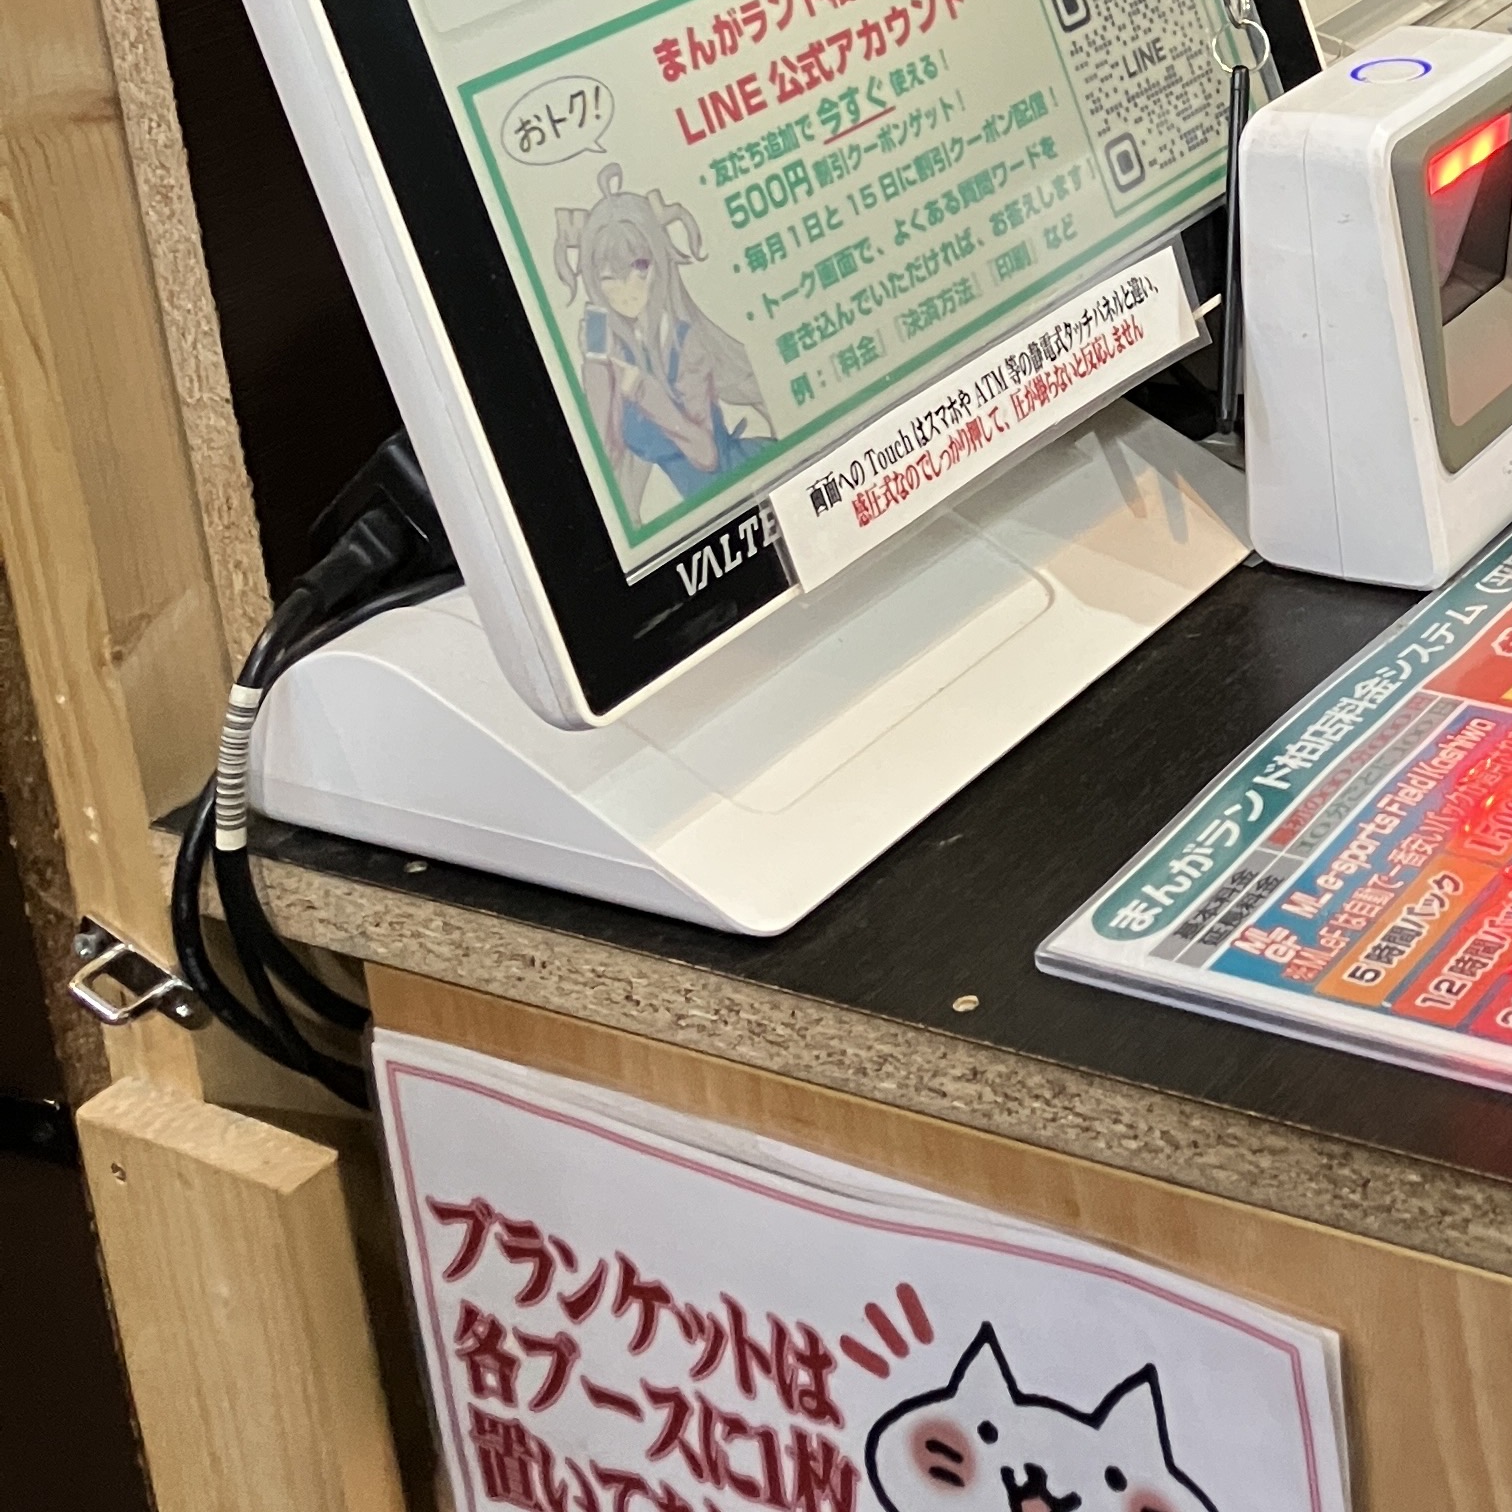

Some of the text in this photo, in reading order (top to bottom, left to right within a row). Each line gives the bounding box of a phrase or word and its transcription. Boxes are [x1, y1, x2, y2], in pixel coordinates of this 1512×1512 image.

[674, 73, 768, 146] LINE
[816, 75, 888, 138] 今すぐ
[1120, 36, 1168, 80] LINE
[723, 157, 814, 231] 500円
[863, 429, 914, 479] Touch
[973, 362, 1010, 402] ATM
[1099, 595, 1491, 937] まんがランド柏店料金システム
[1301, 809, 1416, 894] e-sports
[1371, 770, 1445, 817] Field
[1410, 714, 1499, 780] Kashiwa
[1341, 869, 1475, 988] 5時間パック
[425, 1192, 846, 1431] ブランケットは
